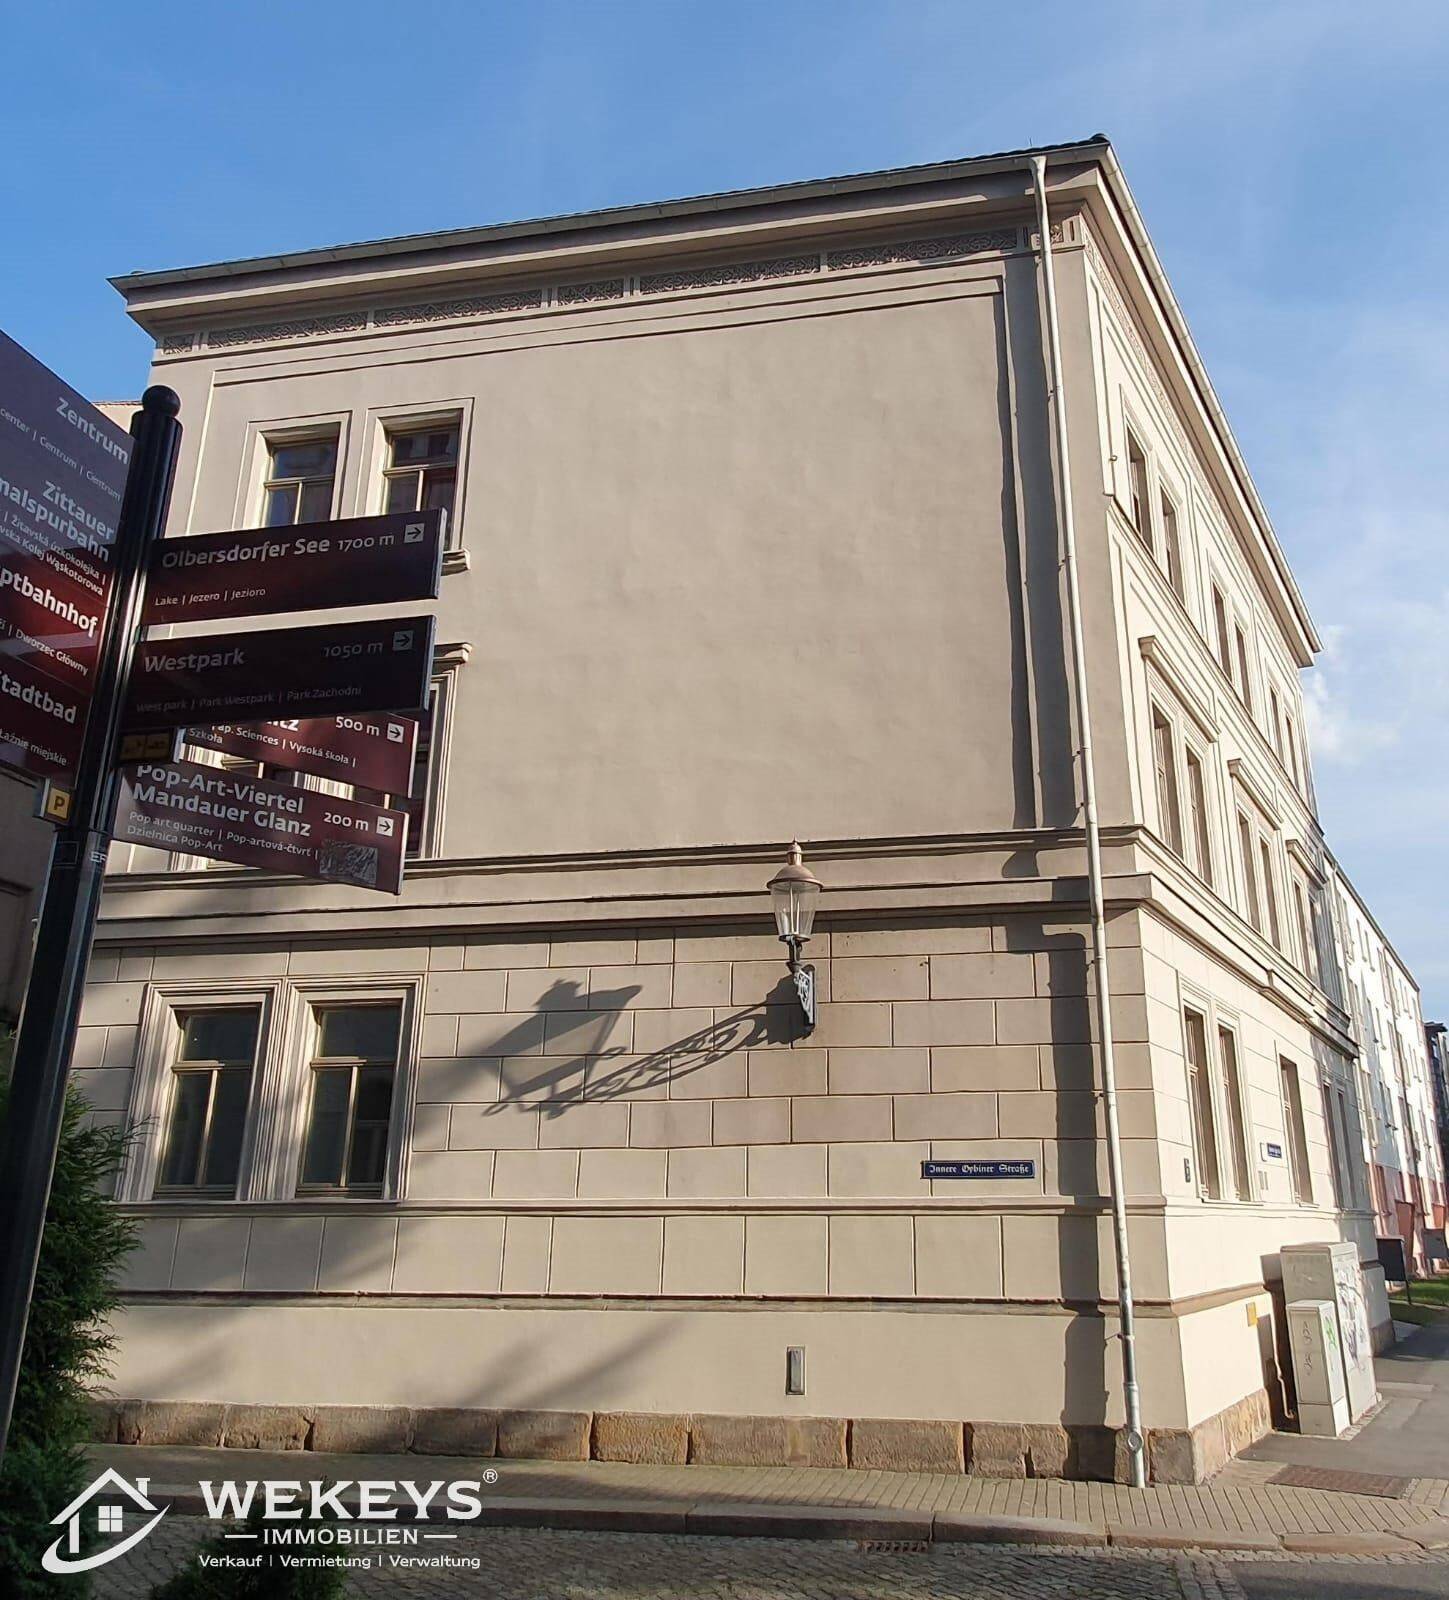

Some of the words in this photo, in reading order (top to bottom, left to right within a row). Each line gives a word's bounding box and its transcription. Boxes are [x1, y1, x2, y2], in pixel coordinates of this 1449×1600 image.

[56, 397, 129, 465] Zentrum
[40, 436, 77, 469] Centrum
[86, 470, 121, 502] Centrum
[43, 480, 115, 539] Zittauer
[161, 540, 290, 569] Olbersdorfer
[294, 537, 331, 556] See
[337, 535, 376, 552] 1700
[378, 533, 395, 547] m
[154, 595, 179, 607] Lake
[188, 591, 220, 605] Jezero
[231, 587, 267, 600] Jezioro
[15, 629, 55, 657] Dworzec
[56, 651, 89, 676] Główny
[143, 647, 246, 674] Westpark
[321, 644, 362, 660] 1050
[365, 641, 384, 655] m
[0, 670, 77, 724] tadtbad
[335, 715, 364, 732] 500
[366, 724, 381, 737] m
[236, 728, 279, 746] Sciences
[289, 741, 323, 757] Vysoká
[325, 750, 349, 764] škola
[53, 795, 66, 811] P
[136, 765, 304, 814] Pop-Art-Viertel
[129, 811, 151, 825] Pop
[152, 816, 171, 829] art
[173, 820, 215, 837] quarter
[133, 783, 250, 823] Mandauer
[253, 811, 312, 837] Glanz
[322, 812, 352, 827] 200
[354, 818, 370, 832] m
[127, 825, 179, 844] Dzielnica
[181, 837, 224, 852] Pop-Art
[929, 1164, 957, 1173] Innere
[961, 1164, 995, 1174] Oybiner
[998, 1163, 1029, 1174] Straße
